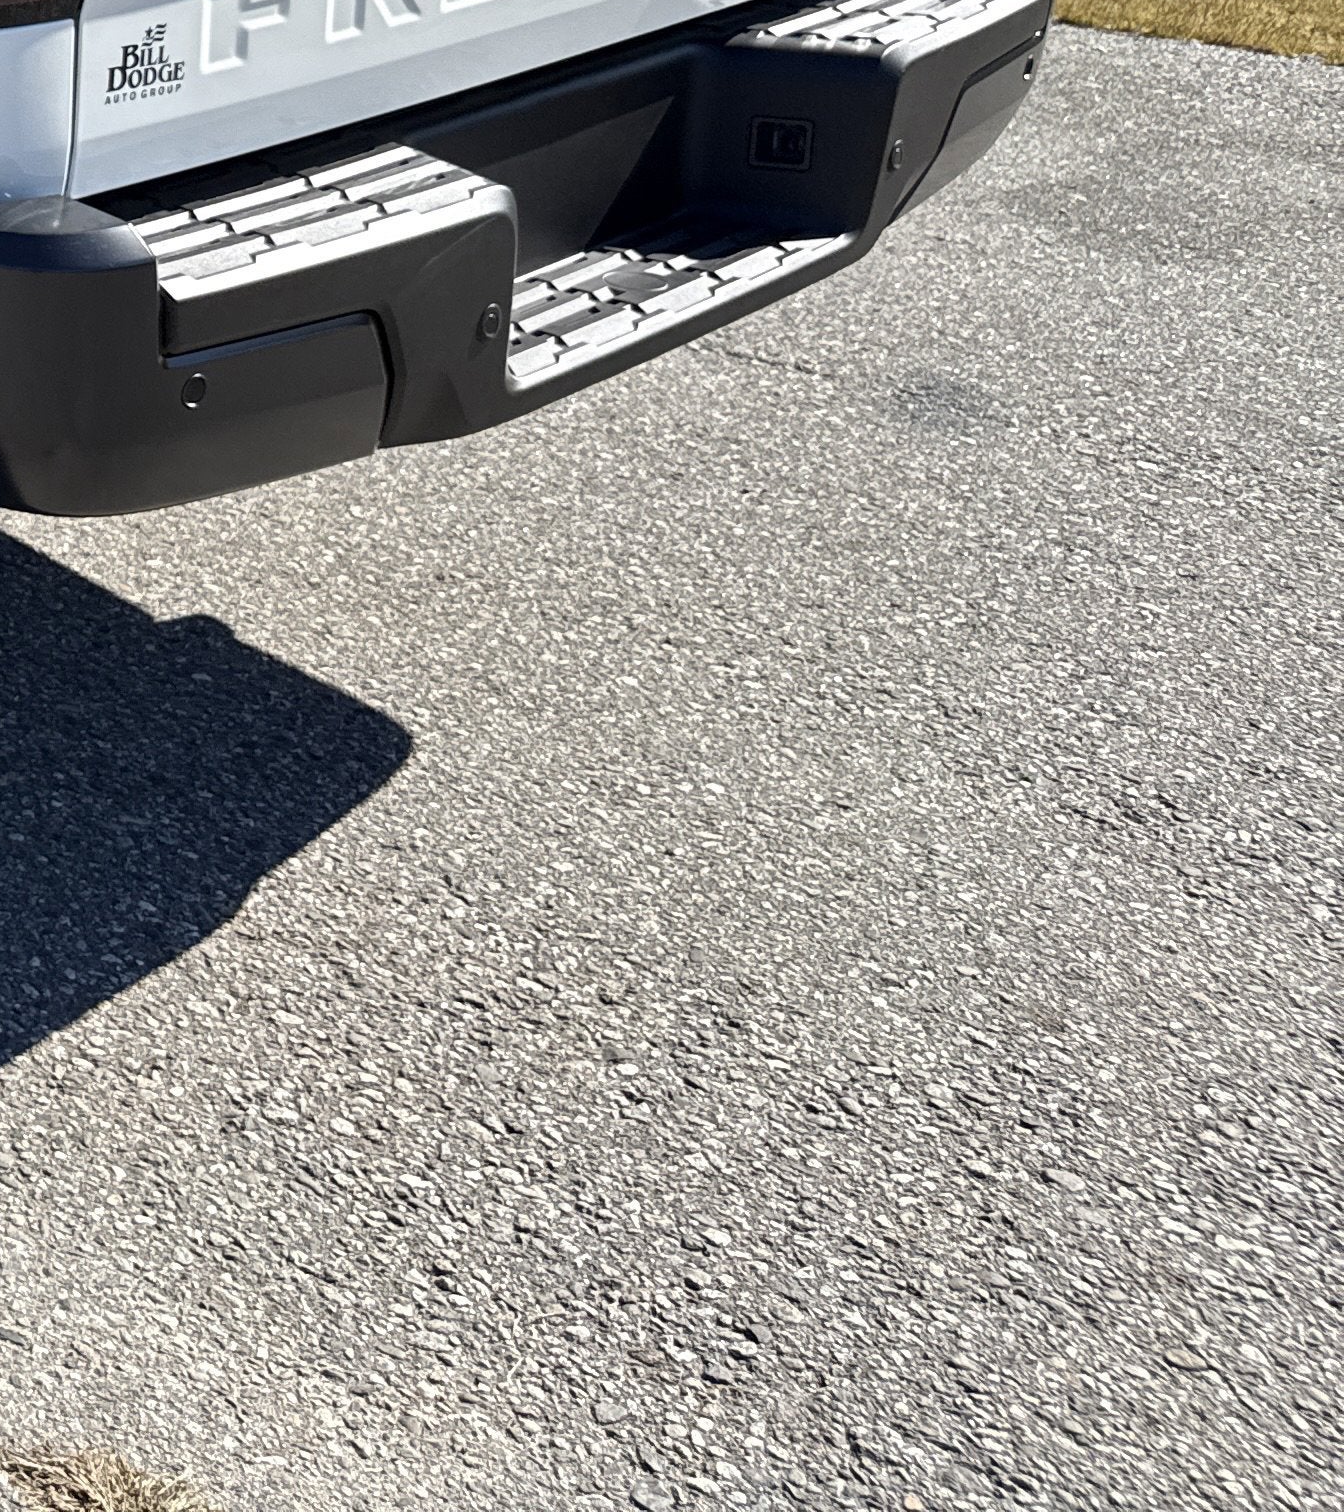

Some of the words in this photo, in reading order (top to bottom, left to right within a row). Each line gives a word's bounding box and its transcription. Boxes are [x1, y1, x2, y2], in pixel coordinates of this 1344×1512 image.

[121, 44, 169, 69] BILL
[106, 61, 185, 92] DODGE
[104, 92, 136, 105] AUTO
[141, 83, 181, 98] GROUP
